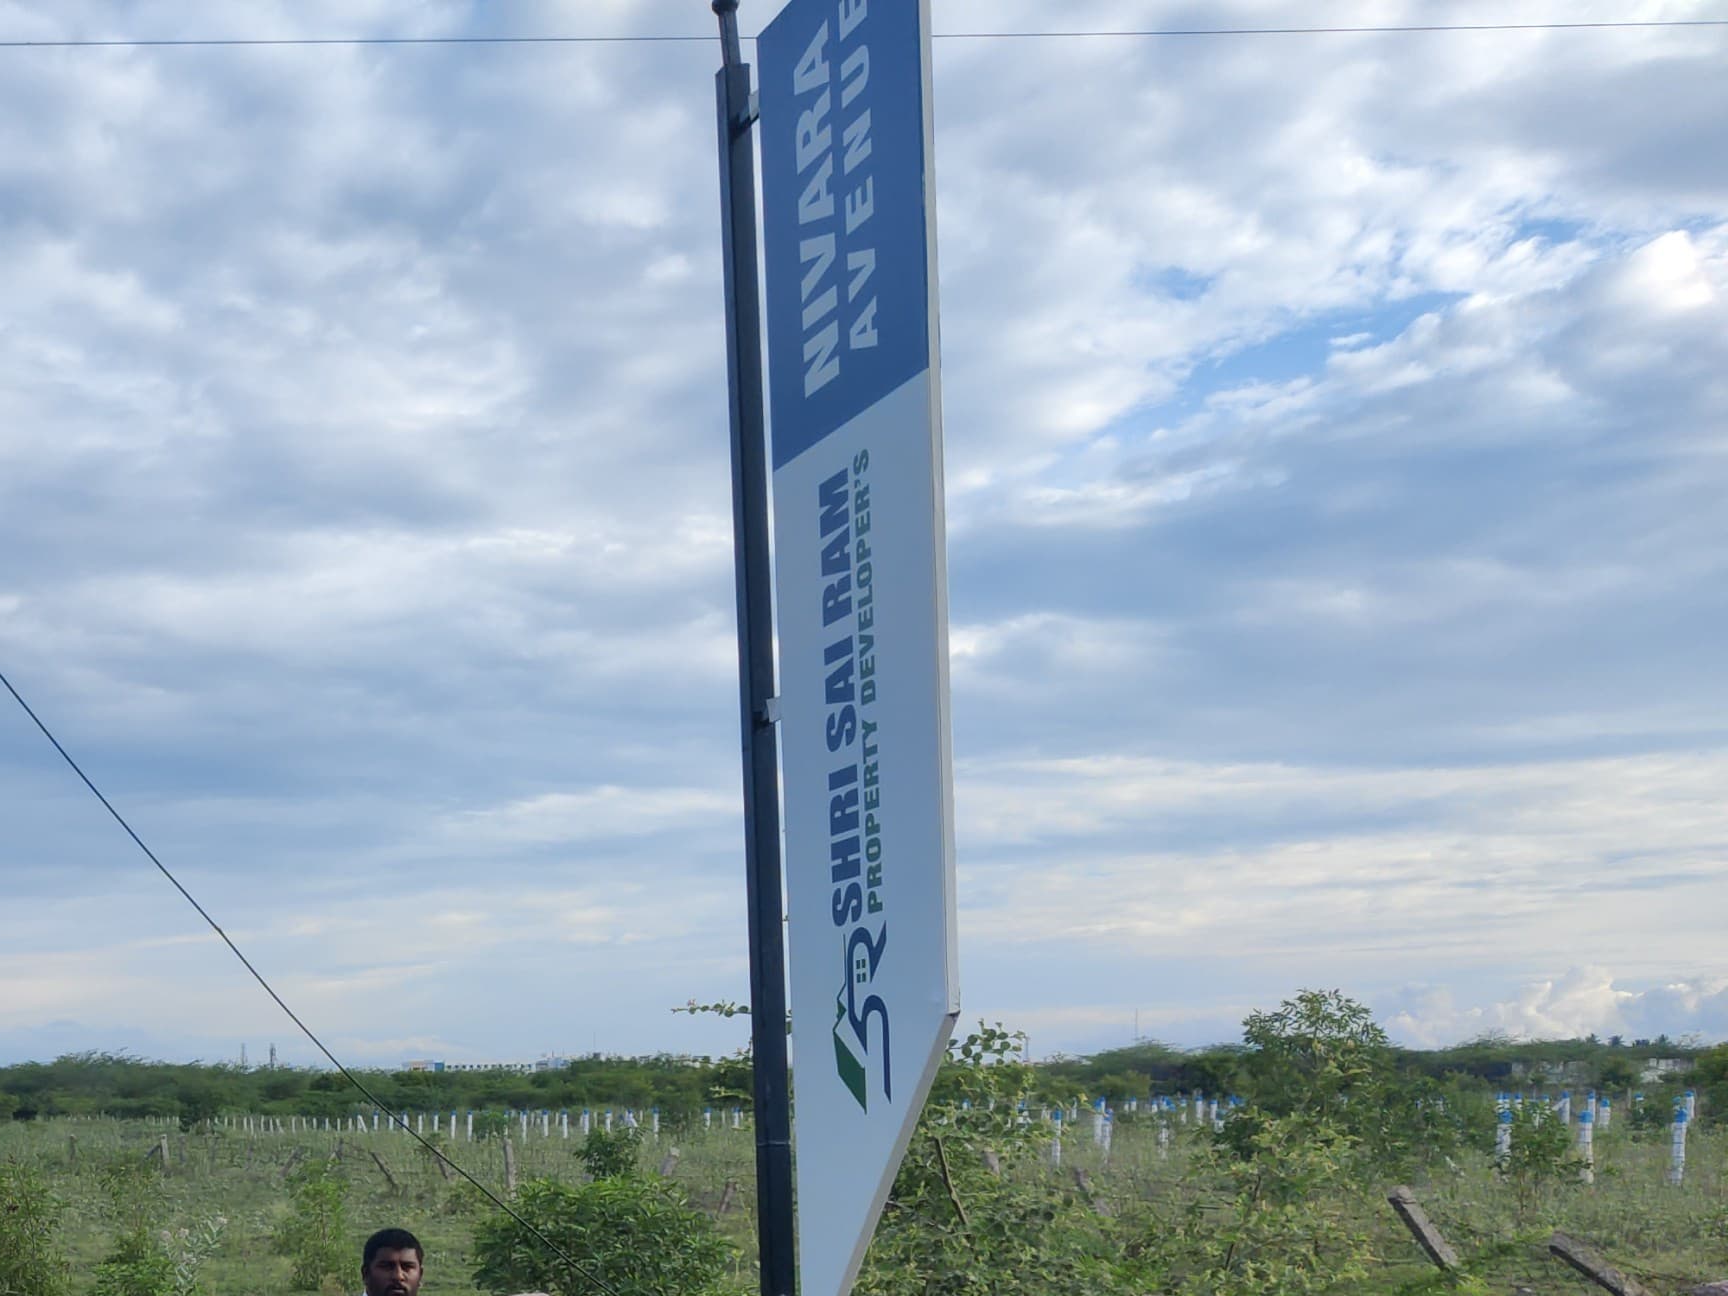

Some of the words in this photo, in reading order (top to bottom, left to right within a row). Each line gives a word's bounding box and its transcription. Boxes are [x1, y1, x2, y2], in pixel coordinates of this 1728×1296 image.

[793, 18, 841, 400] NIVARA
[838, 0, 878, 350] AVENUE
[818, 467, 852, 628] RAM
[852, 448, 877, 706] DEVELOPER'S
[824, 634, 857, 753] SAI
[829, 763, 863, 928] SHRI
[860, 718, 884, 915] PROPERTY
